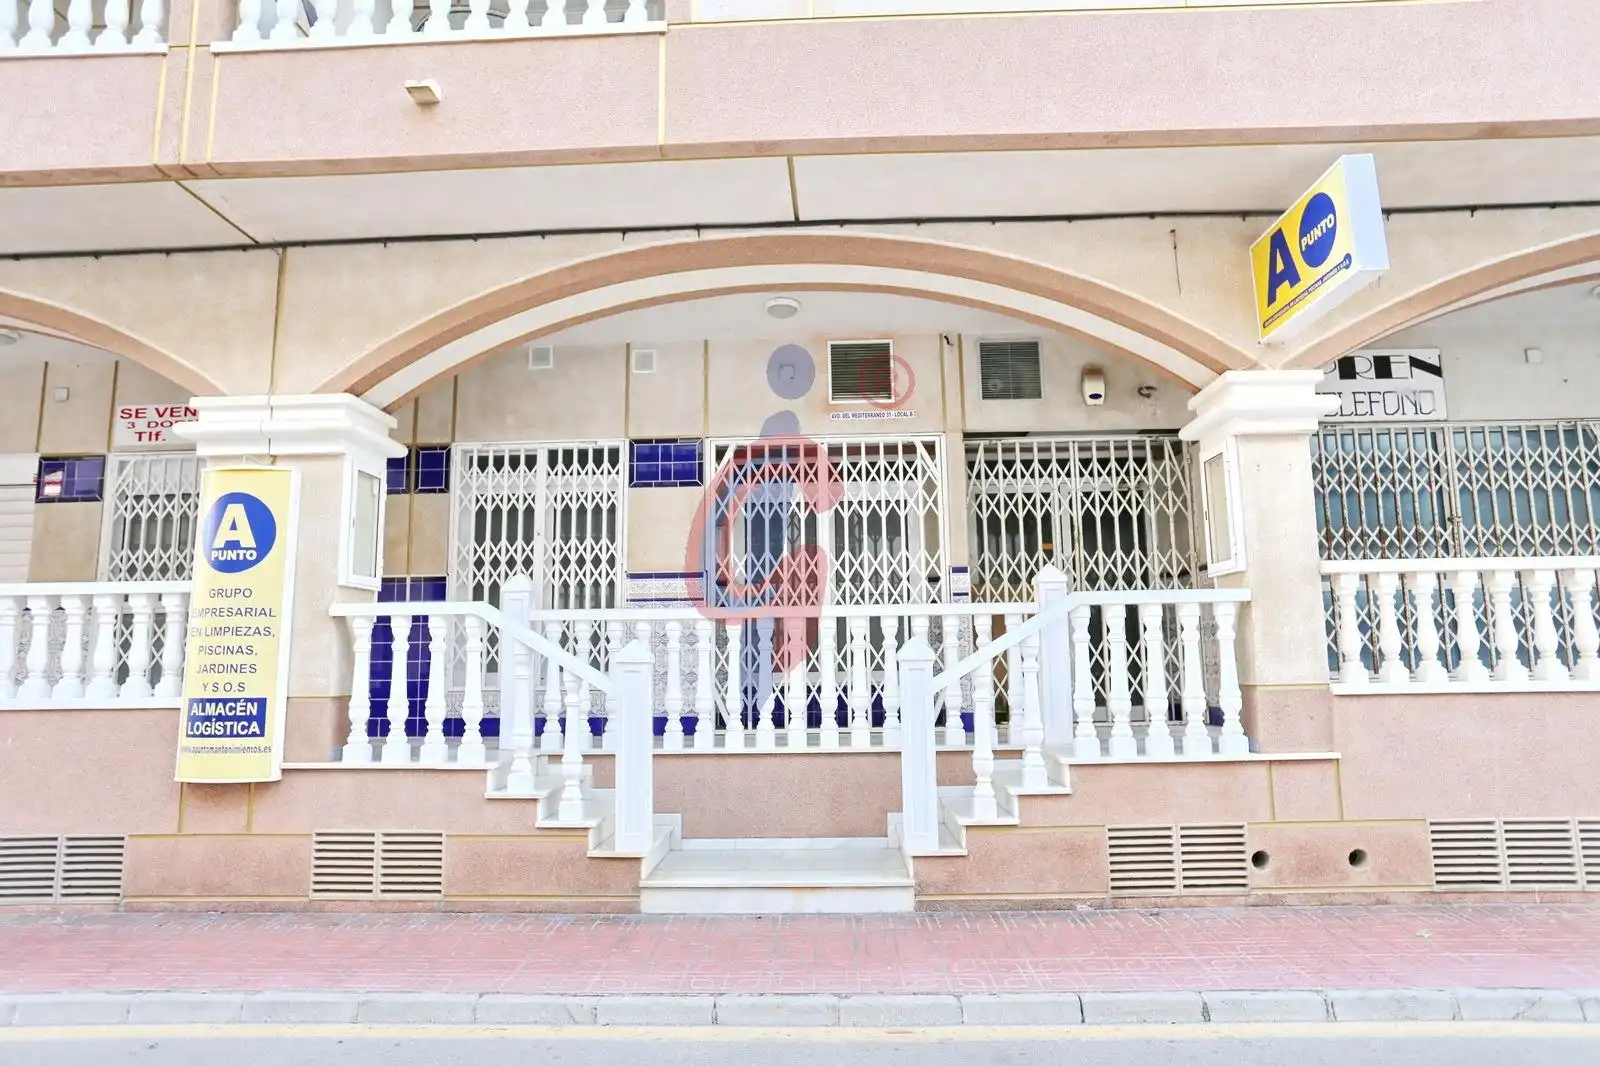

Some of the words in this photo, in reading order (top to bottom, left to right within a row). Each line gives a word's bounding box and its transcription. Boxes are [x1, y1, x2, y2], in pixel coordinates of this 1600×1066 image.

[1267, 227, 1301, 308] A
[1300, 212, 1335, 251] PUNTO
[1315, 390, 1436, 417] LEFONO
[120, 407, 147, 419] SE
[155, 406, 199, 418] VEN
[212, 503, 257, 549] A
[211, 550, 258, 561] PUNTO
[208, 588, 253, 599] GRUPO
[192, 607, 277, 618] EMPRESARIAL
[191, 627, 203, 637] EN
[204, 626, 275, 638] LIMPIEZAS,
[197, 664, 258, 675] JARDINES
[202, 682, 209, 693] Y
[191, 699, 258, 716] ALMACÉN
[187, 718, 260, 736] LOGÍSTICA
